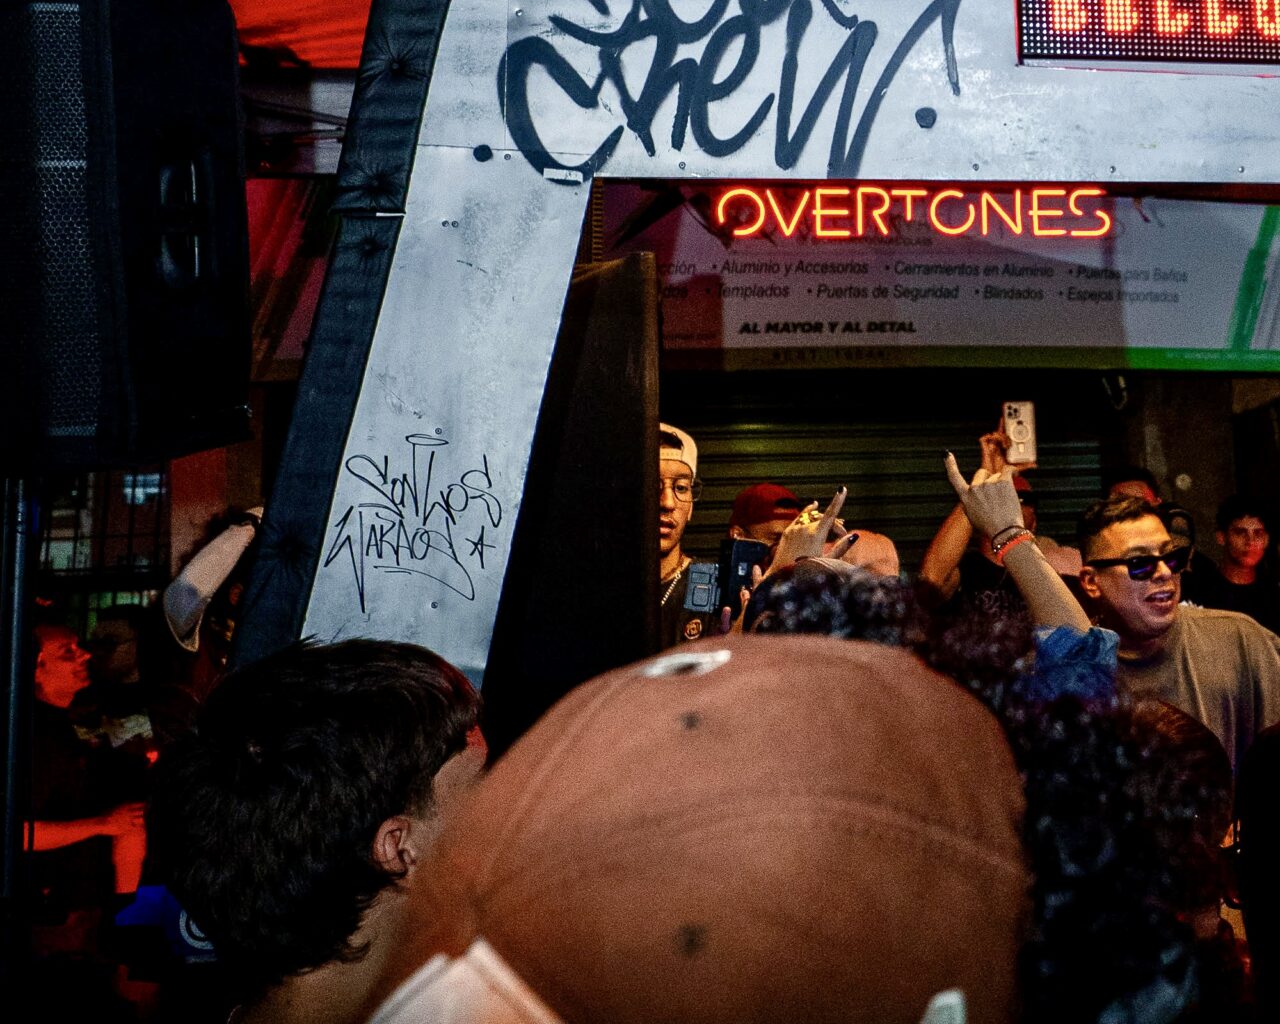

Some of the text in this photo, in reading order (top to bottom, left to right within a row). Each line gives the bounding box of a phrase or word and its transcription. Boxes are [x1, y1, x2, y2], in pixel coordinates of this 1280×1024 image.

[715, 187, 1113, 239] OVERTONES
[720, 260, 781, 274] Aluminio
[784, 264, 793, 276] y
[794, 260, 869, 274] Accesorios
[893, 260, 980, 276] Cerramientos
[816, 284, 868, 299] Puertas
[872, 285, 889, 298] de
[893, 285, 960, 302] Seguridad
[983, 285, 1044, 300] Blindados
[1067, 286, 1114, 302] Espejos
[739, 321, 916, 334] AL MAYOR Y AL DETAL
